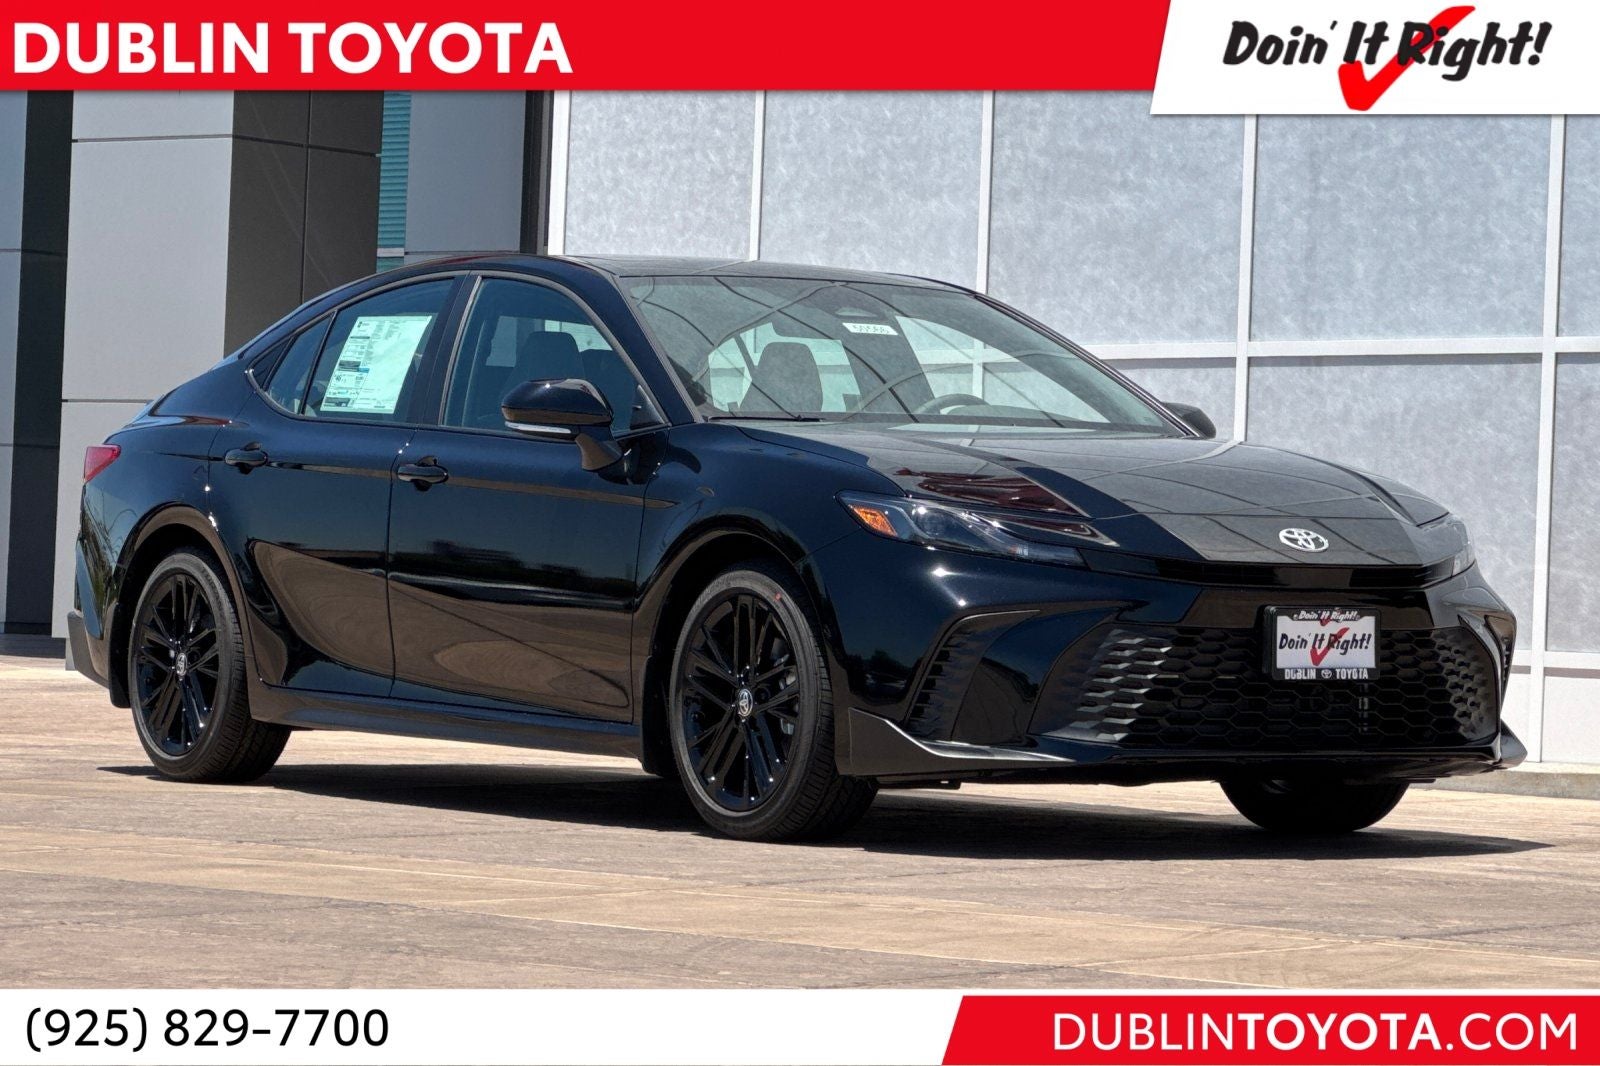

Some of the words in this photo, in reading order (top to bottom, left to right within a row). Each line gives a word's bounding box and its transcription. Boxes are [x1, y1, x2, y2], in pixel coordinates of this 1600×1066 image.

[1279, 632, 1312, 650] Doin'
[1312, 633, 1325, 650] It
[1328, 633, 1372, 656] Right!
[1284, 668, 1317, 680] DUBLIN
[1335, 668, 1369, 680] TOYOTA
